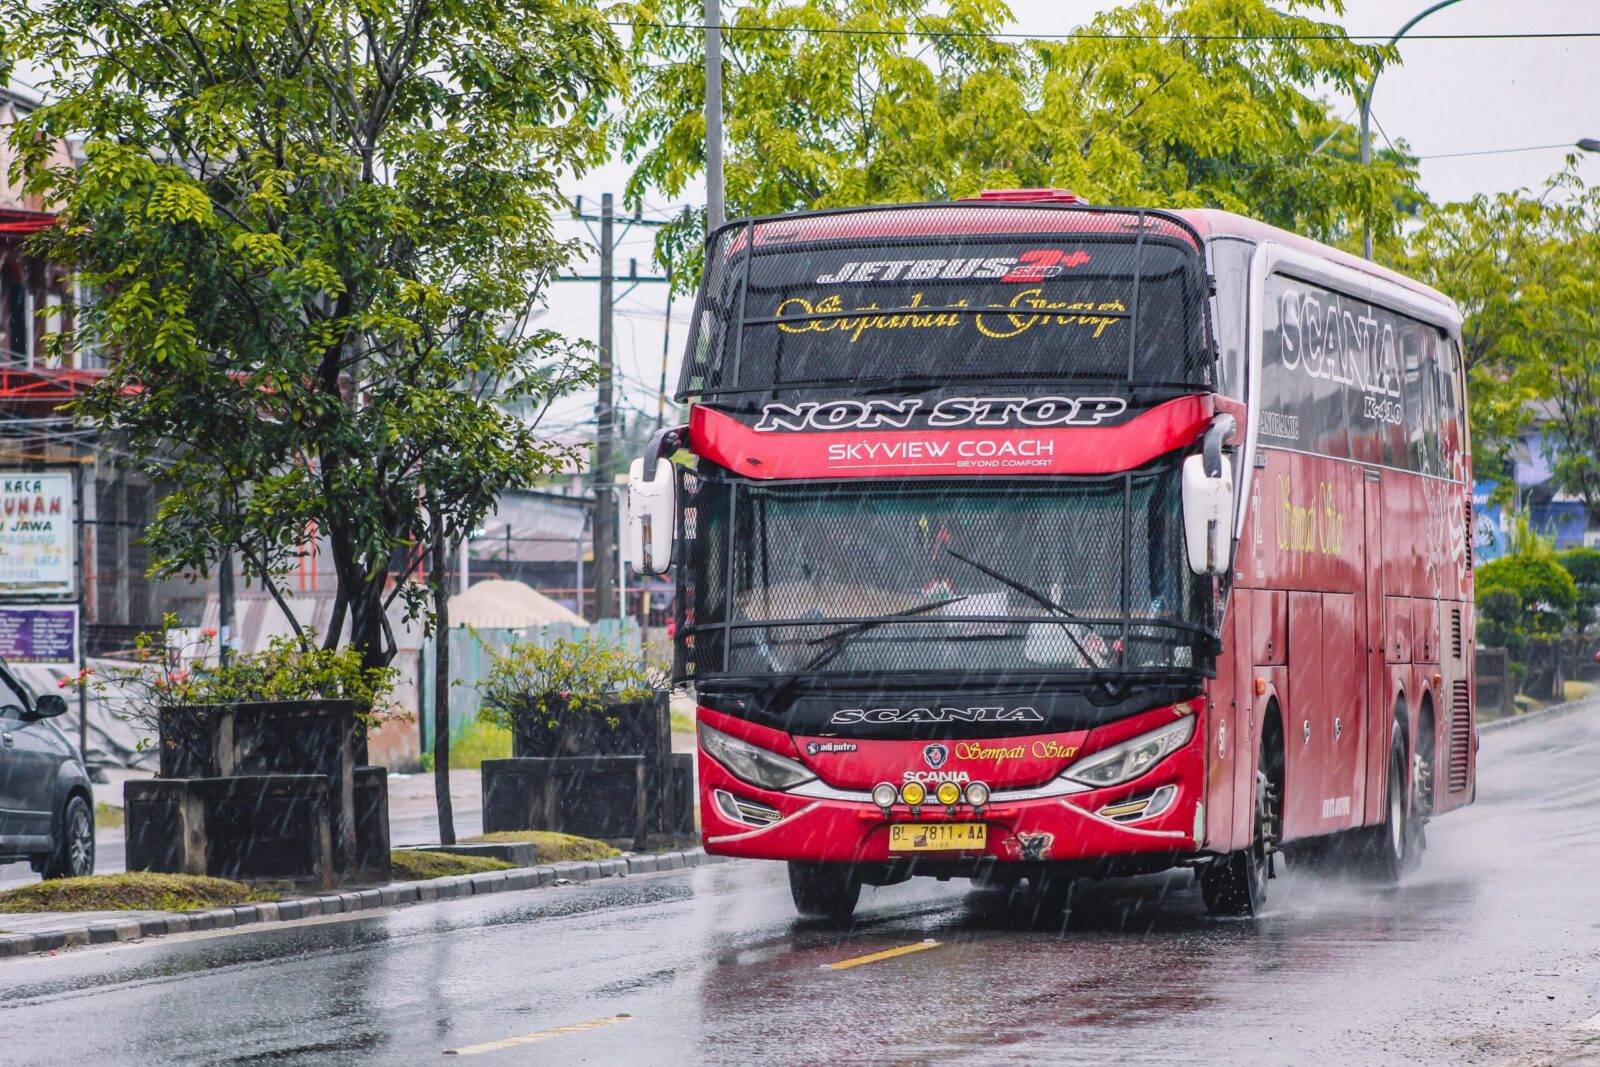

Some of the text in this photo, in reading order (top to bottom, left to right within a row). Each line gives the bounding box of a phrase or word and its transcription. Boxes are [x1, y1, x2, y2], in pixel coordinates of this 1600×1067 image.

[976, 288, 1125, 338] Group
[1281, 288, 1400, 397] SCANIA
[754, 397, 1127, 431] NON STOP
[1257, 410, 1299, 440] ANORAMIC
[828, 440, 1054, 460] SKYVIEW COACH
[957, 459, 1053, 468] BEYOND COMFORT
[5, 480, 42, 492] KACA
[0, 495, 61, 517] UNAN
[11, 521, 52, 532] JAWA
[831, 707, 1044, 724] SCANIA
[955, 741, 1080, 764] Sempati Star
[903, 770, 970, 783] SCANIA
[893, 825, 984, 841] BL 7811 AA
